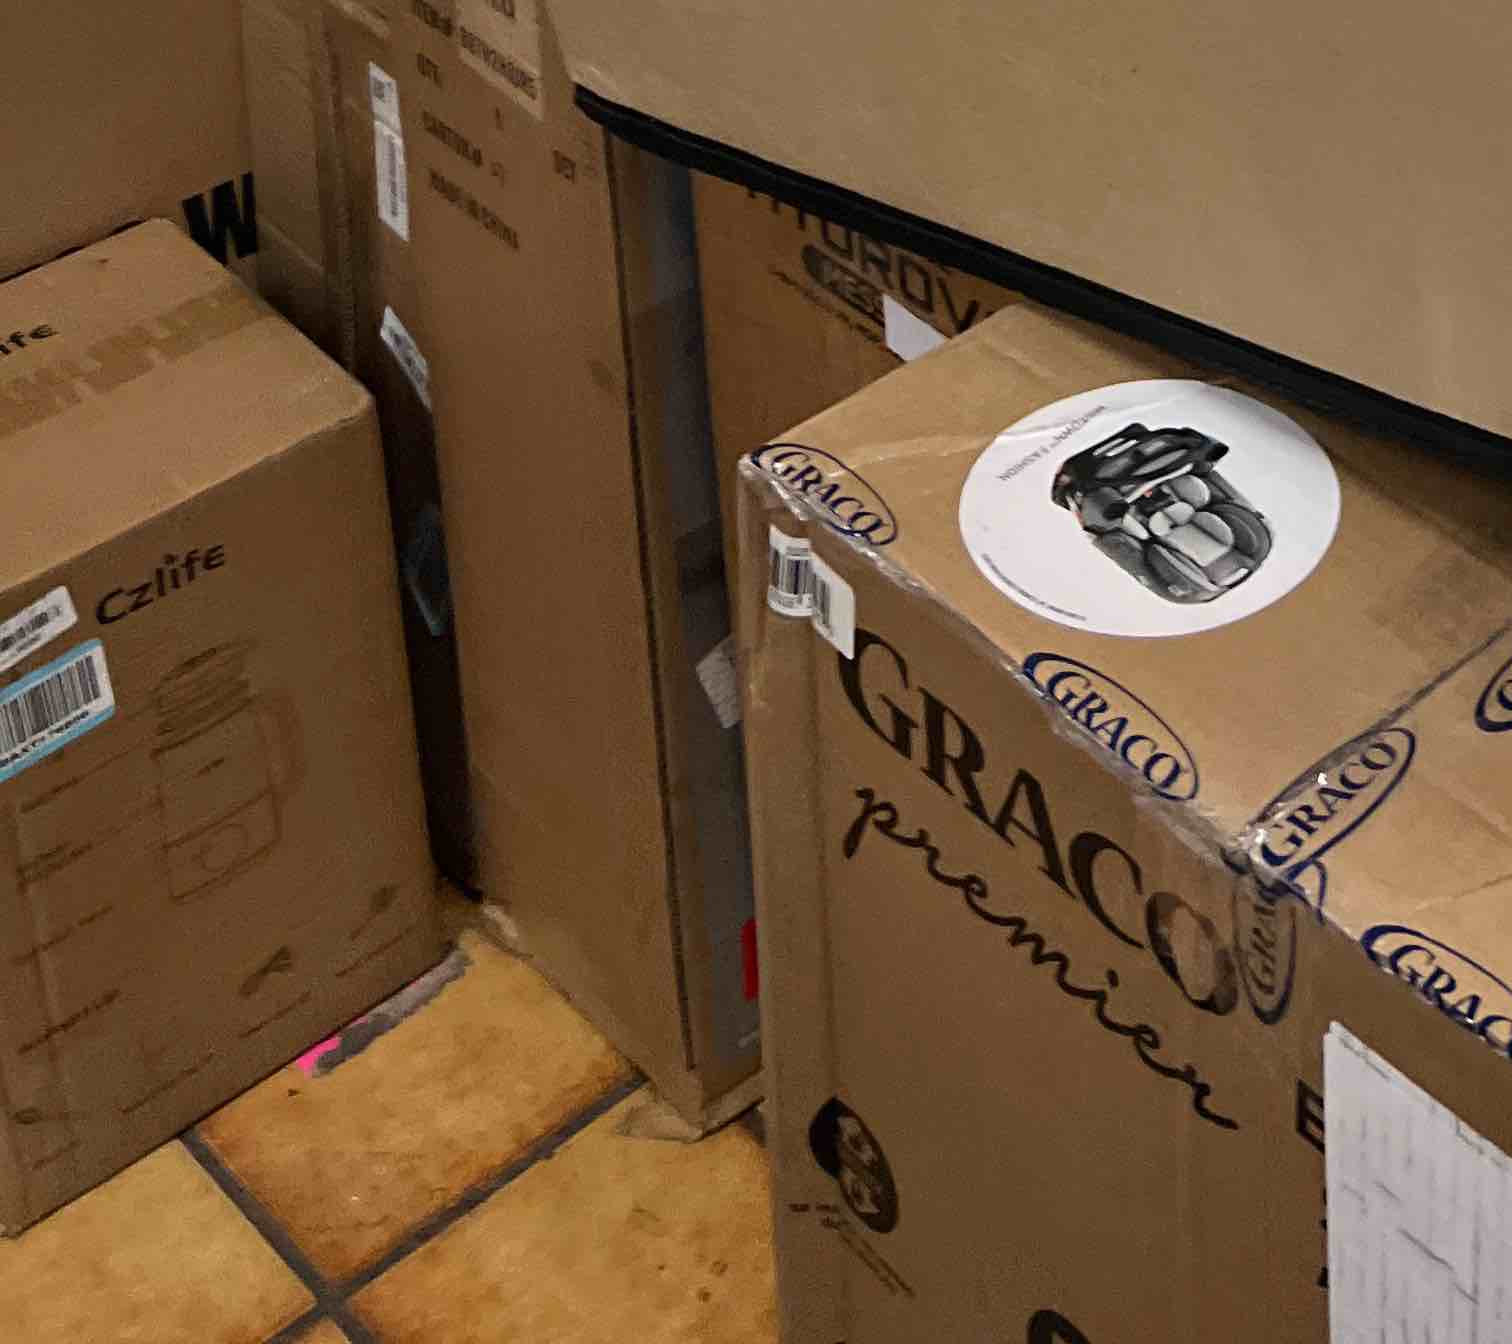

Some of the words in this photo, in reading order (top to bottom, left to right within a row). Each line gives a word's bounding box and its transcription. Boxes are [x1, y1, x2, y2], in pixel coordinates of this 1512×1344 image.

[770, 450, 886, 535] GRACO
[95, 544, 225, 625] Czlife
[1044, 670, 1185, 792] GRACO
[837, 627, 1239, 1016] GRACO
[1259, 740, 1397, 867] GRACO
[843, 787, 1240, 1129] premier
